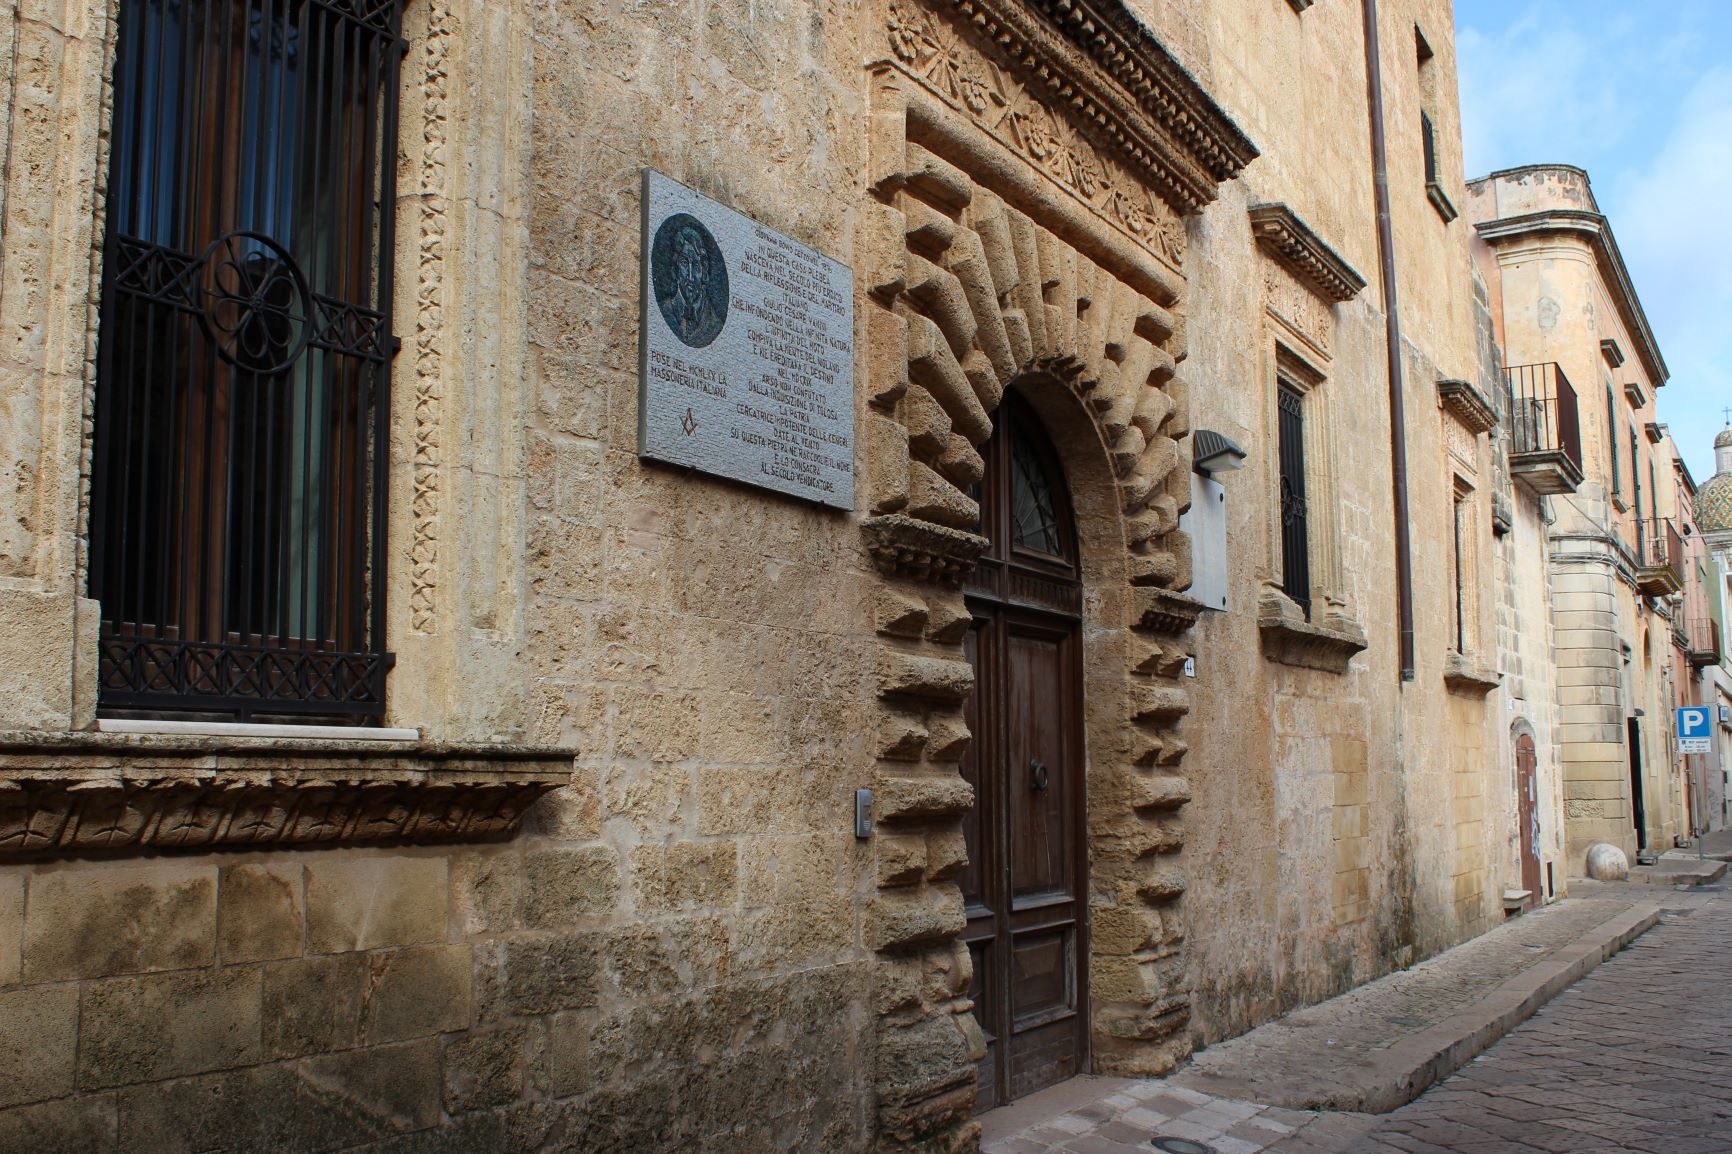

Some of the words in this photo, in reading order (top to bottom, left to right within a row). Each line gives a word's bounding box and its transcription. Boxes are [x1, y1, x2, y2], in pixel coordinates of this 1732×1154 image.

[744, 249, 772, 272] NASCEVA
[774, 263, 785, 278] NEL
[788, 269, 810, 289] SECOLO
[758, 243, 764, 255] IN
[766, 247, 789, 267] QUESTA
[792, 259, 806, 274] CASA
[808, 266, 830, 285] PLEBEA
[740, 260, 760, 279] DELLA
[808, 290, 818, 304] DEL
[763, 296, 782, 313] GIULIO
[784, 305, 806, 323] CESARE
[732, 295, 744, 311] CHE
[785, 317, 803, 335] NELLA
[829, 336, 850, 354] NATURA
[747, 328, 773, 348] COMPIVA
[774, 339, 783, 352] LA
[805, 351, 816, 365] DEL
[796, 335, 808, 349] DEL
[809, 340, 824, 356] MOTO
[651, 350, 670, 366] POSE
[673, 357, 686, 372] NEL
[718, 373, 727, 386] LA
[651, 363, 694, 390] MASSONERIA
[777, 366, 790, 379] NEL
[810, 365, 833, 384] DESTINO
[748, 380, 768, 397] DALLA
[809, 402, 814, 413] DI
[817, 404, 837, 420] TOLOSA
[761, 373, 777, 388] ARSO
[779, 380, 791, 392] NON
[793, 384, 826, 405] CONFUTATO
[736, 402, 773, 424] CERCATRICE
[808, 426, 826, 441] DELLE
[779, 404, 787, 416] LA
[789, 408, 809, 423] PATRIA
[730, 427, 738, 440] SU
[741, 430, 765, 448] QUESTA
[767, 438, 787, 454] PIETRA
[789, 445, 796, 457] NE
[829, 457, 834, 468] IL
[773, 427, 789, 442] DATE
[791, 433, 798, 445] AL
[760, 462, 769, 474] AL
[771, 465, 794, 481] SECOLO
[780, 455, 788, 467] LO
[1682, 710, 1704, 735] P
